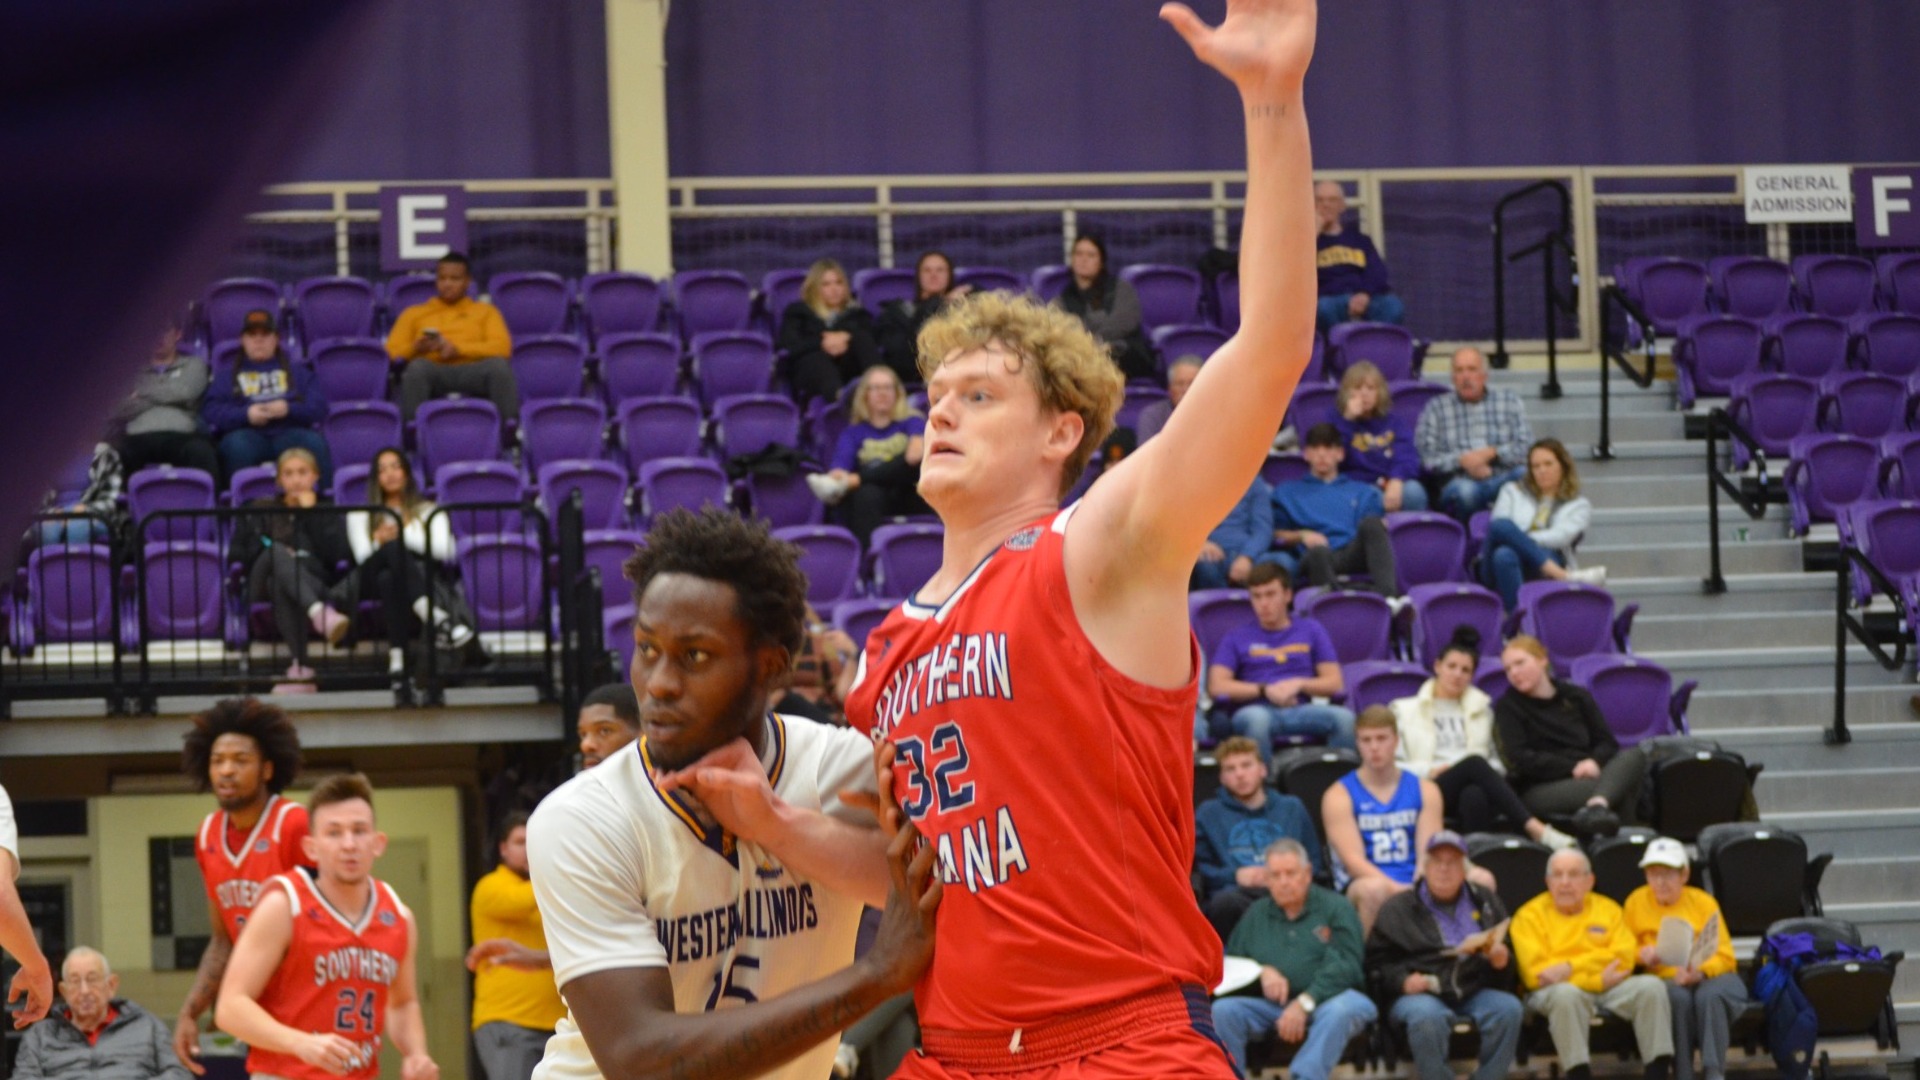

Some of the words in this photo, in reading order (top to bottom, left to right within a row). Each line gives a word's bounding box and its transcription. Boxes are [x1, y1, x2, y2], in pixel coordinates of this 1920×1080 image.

[1750, 196, 1848, 213] ADMISSION
[1755, 174, 1841, 192] GENERAL
[1871, 175, 1914, 237] F
[397, 194, 450, 259] E
[892, 721, 977, 822] 32
[1372, 828, 1410, 864] 23
[741, 881, 819, 939] LLINOIS
[335, 987, 376, 1033] 24
